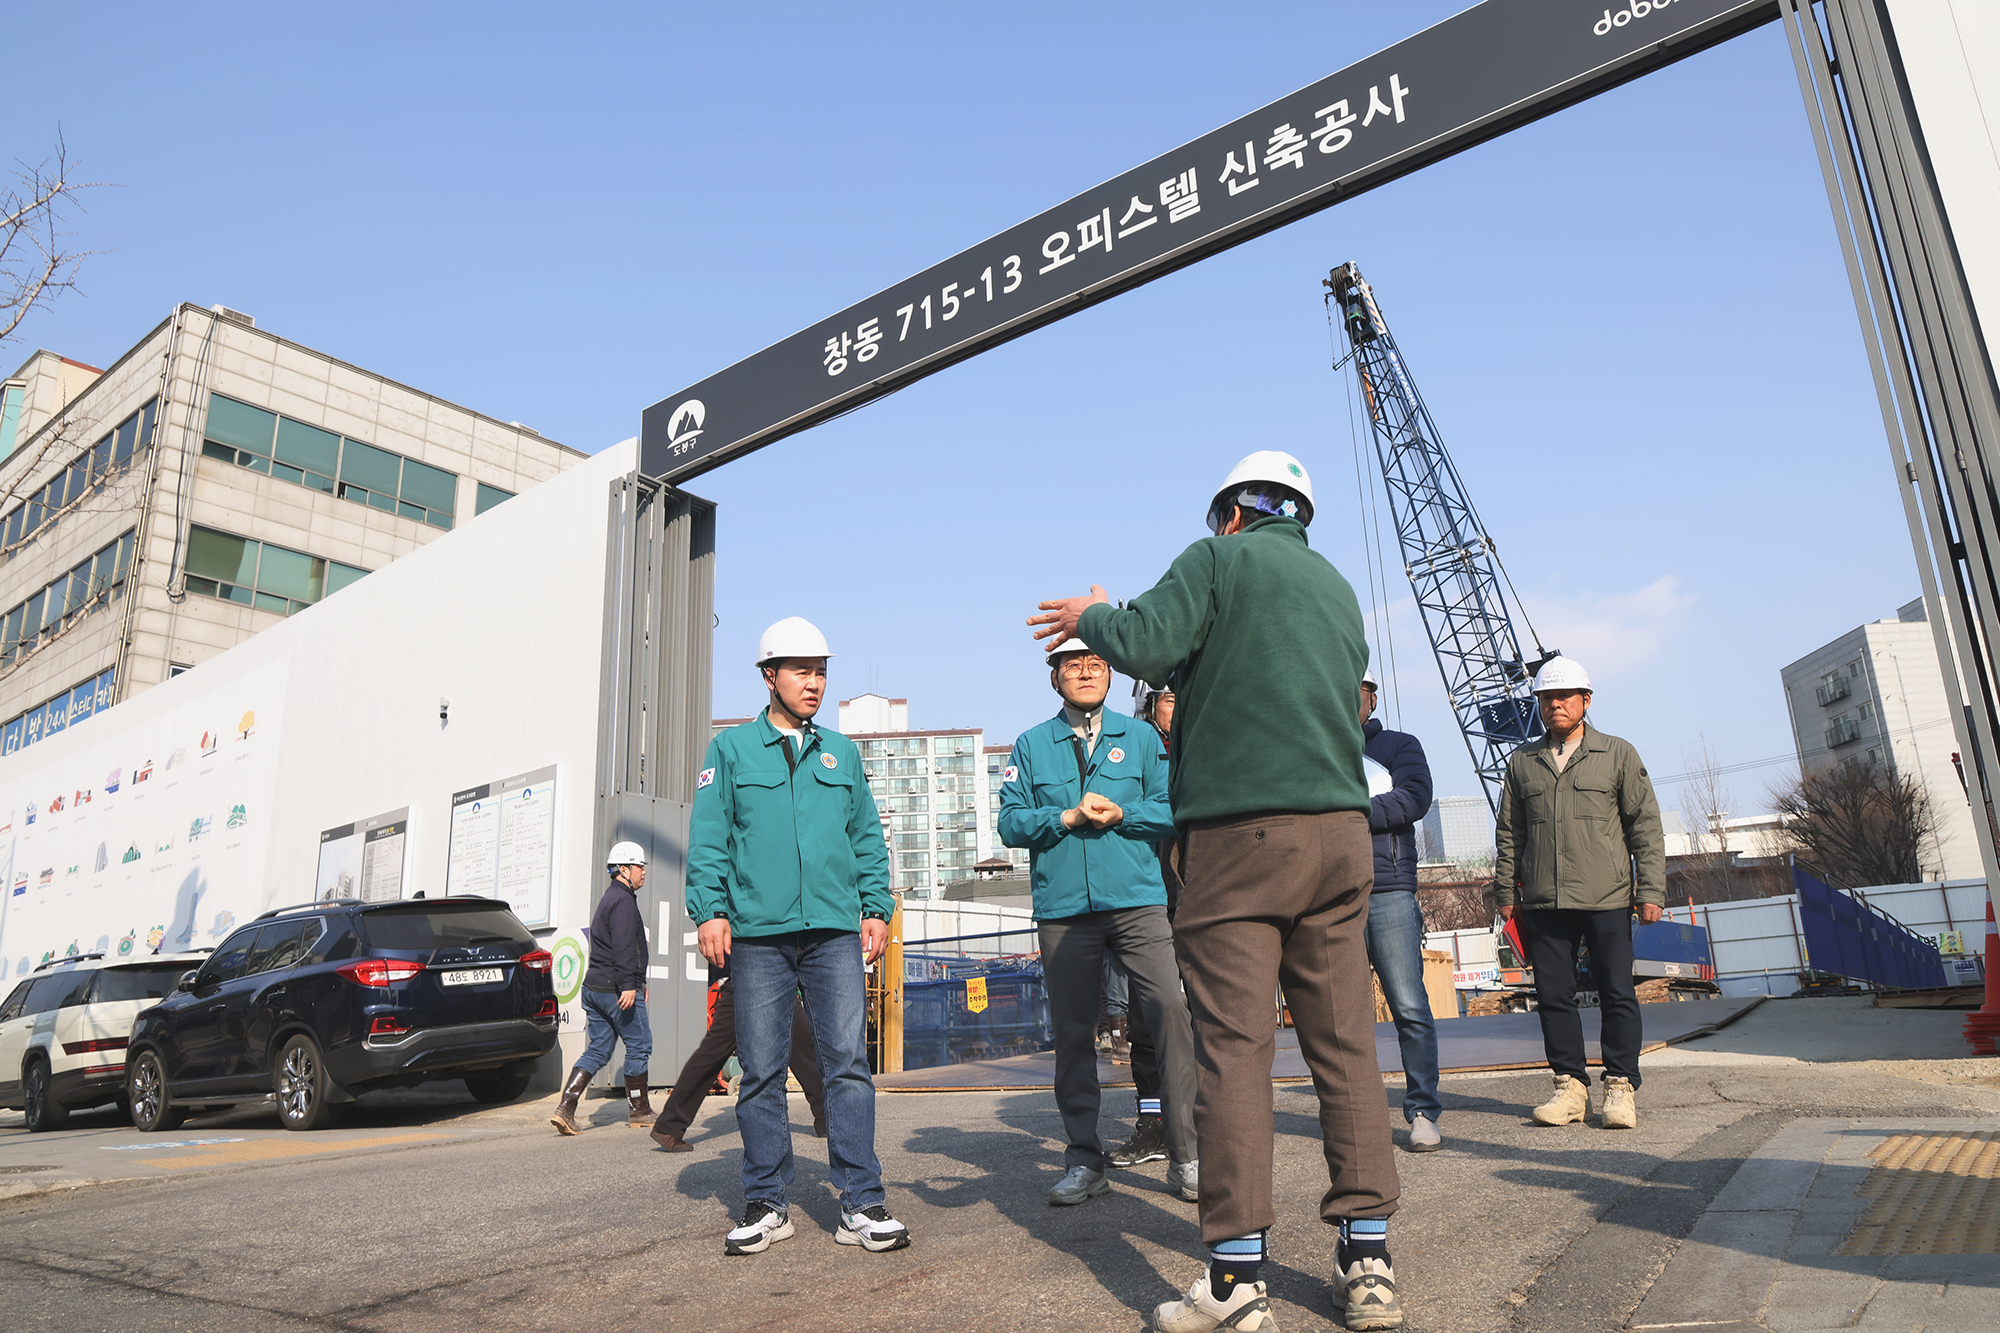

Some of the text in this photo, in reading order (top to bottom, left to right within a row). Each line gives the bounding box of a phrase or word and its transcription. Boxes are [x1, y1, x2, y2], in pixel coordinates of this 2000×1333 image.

[823, 73, 1410, 377] 창동 715-13 오피스텔 신축공사
[1394, 363, 1417, 406] HITACHI
[673, 437, 697, 457] 도봉구
[449, 969, 498, 983] 48도 8921
